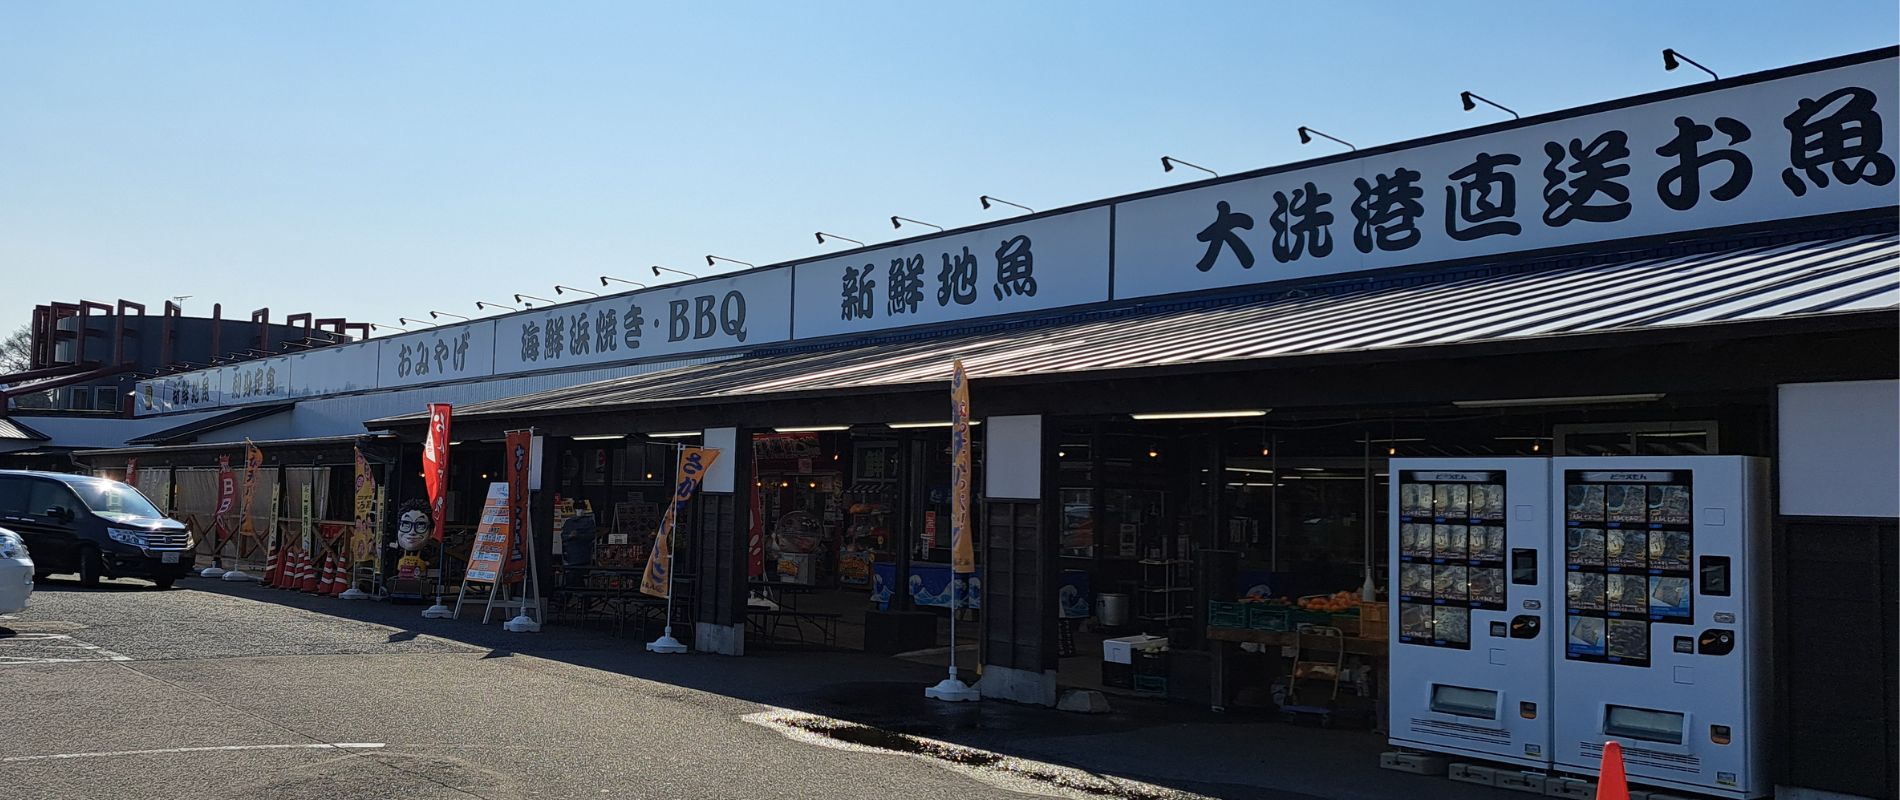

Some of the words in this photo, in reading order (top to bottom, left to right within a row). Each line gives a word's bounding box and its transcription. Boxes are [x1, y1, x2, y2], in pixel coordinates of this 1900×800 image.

[1195, 86, 1896, 272] 大洗港直送お魚
[841, 234, 1037, 321] 新鮮地魚
[398, 329, 471, 378] おみやげ
